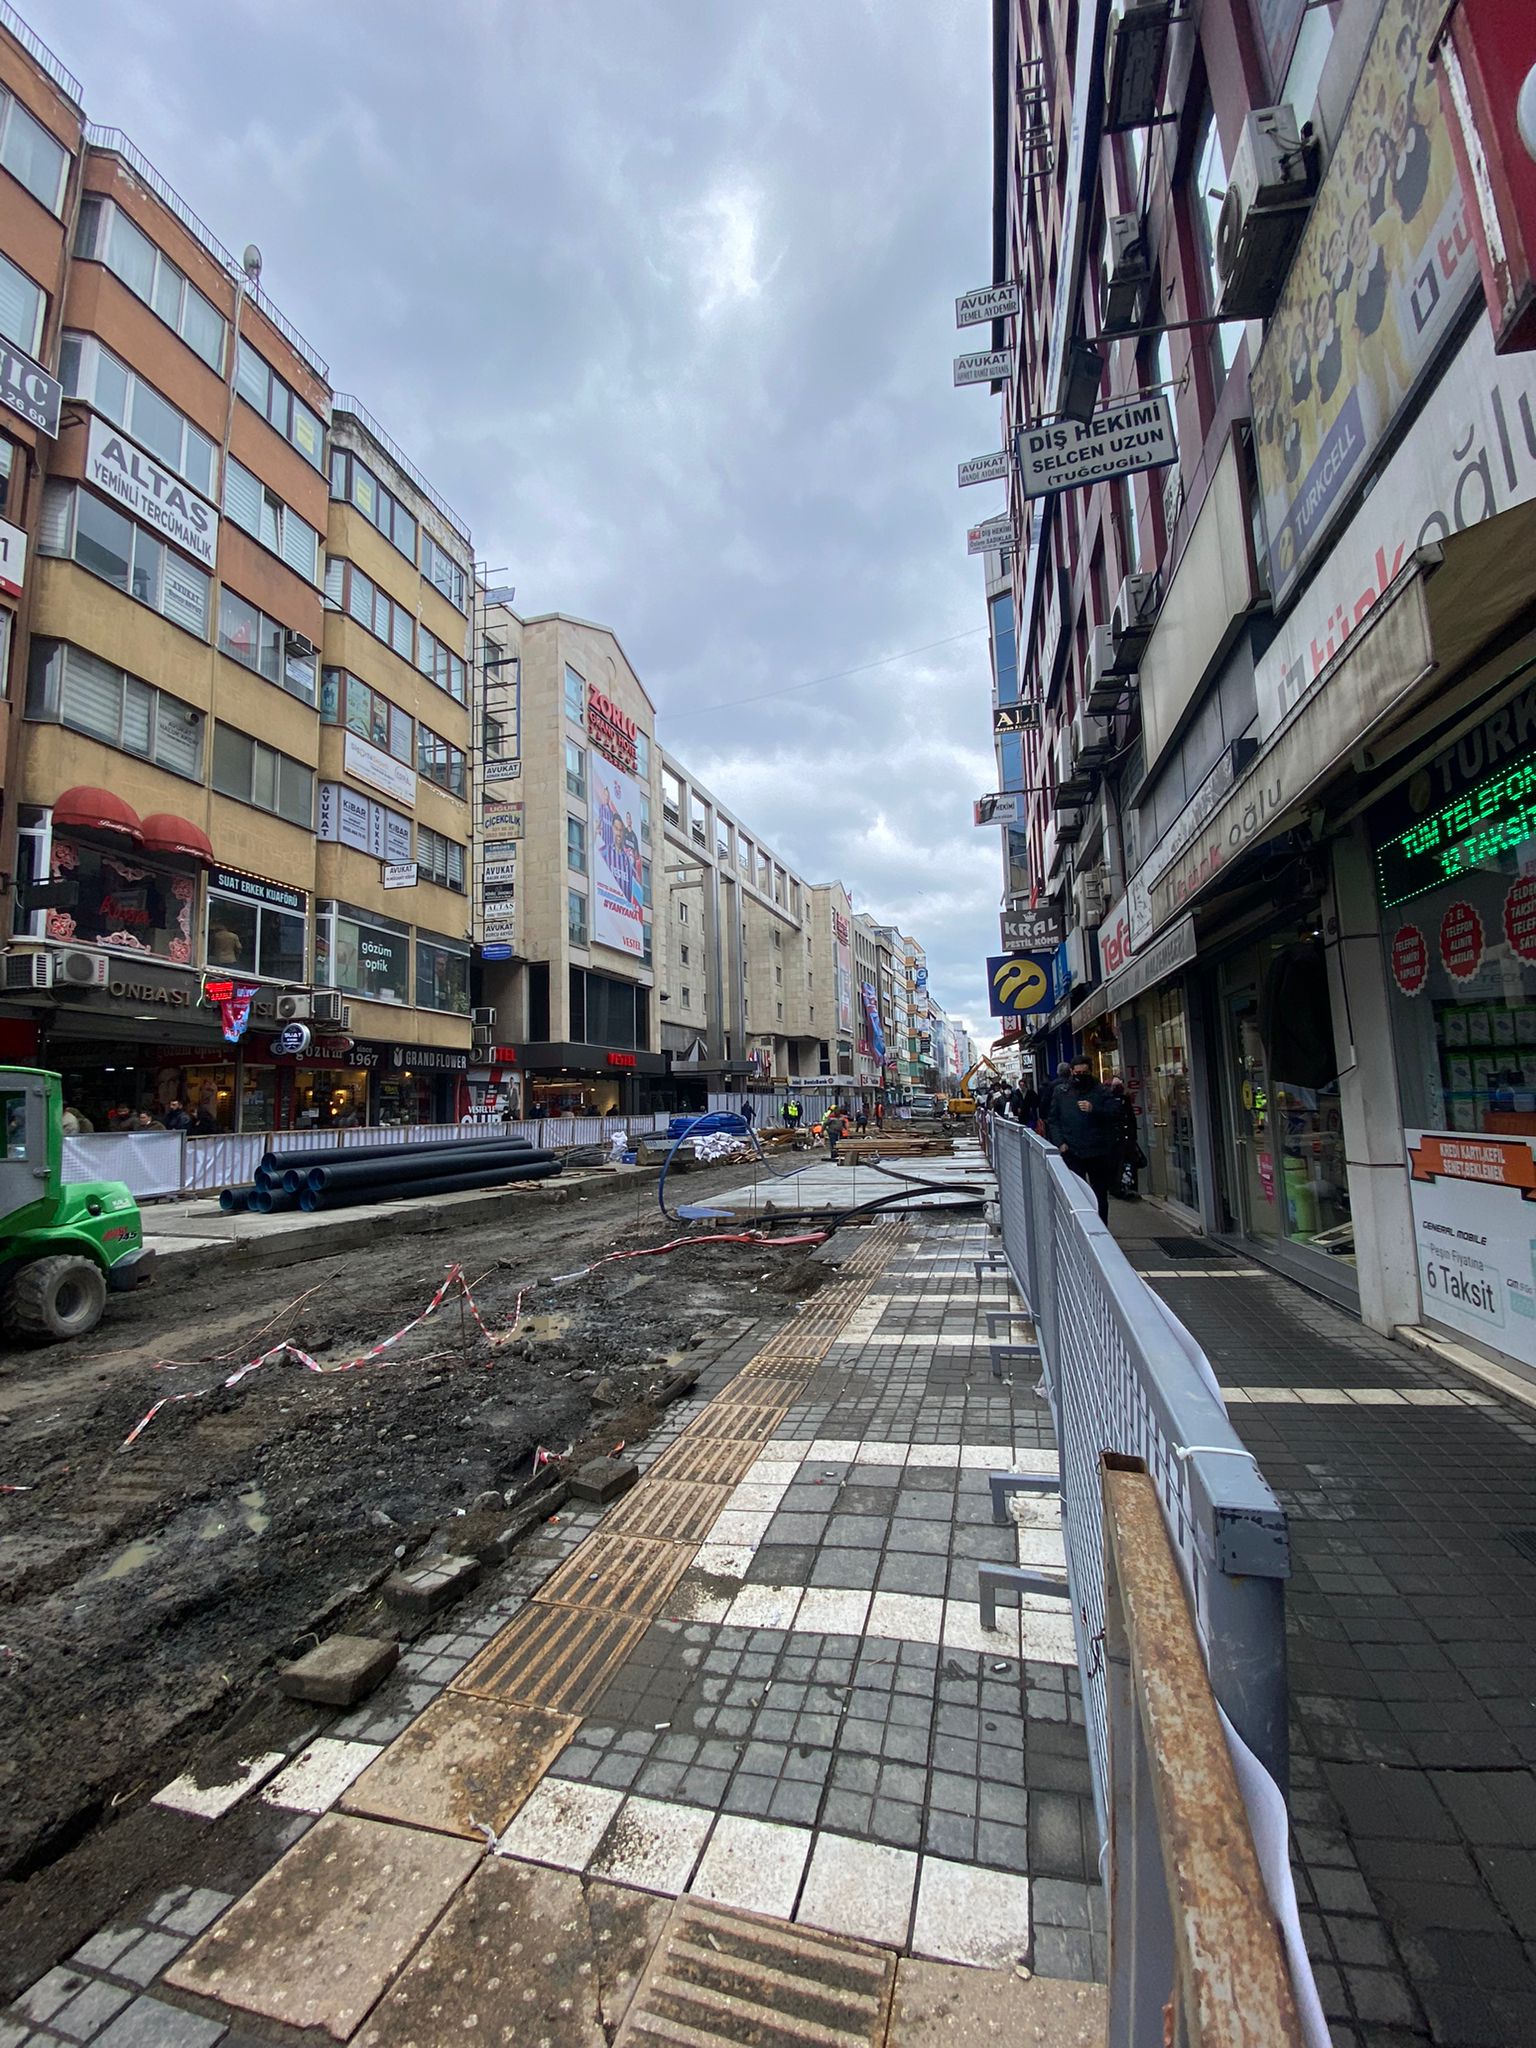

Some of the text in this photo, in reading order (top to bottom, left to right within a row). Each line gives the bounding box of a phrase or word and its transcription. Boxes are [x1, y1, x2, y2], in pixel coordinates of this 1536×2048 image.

[960, 287, 1015, 311] AVUKAT
[960, 300, 1017, 323] TEMEL AYDEMİR
[958, 353, 1008, 371] AVUKAT
[29, 407, 47, 427] 60
[1029, 401, 1162, 454] DİŞ HEKİMİ
[1032, 428, 1164, 473] SELCEN UZUN
[961, 456, 1005, 474] AVUKAT
[1047, 451, 1154, 486] (TUĞCUGİL)
[101, 437, 209, 534] ALTAŞ
[1294, 423, 1357, 537] TURKCELL
[94, 458, 213, 561] YEMİNLİ TERCÜMANLIK
[588, 683, 638, 742] ZORLU
[996, 704, 1036, 727] ALİ
[486, 764, 518, 774] AVUKAT
[321, 786, 330, 837] AVUKAT
[390, 865, 413, 875] AVUKAT
[486, 864, 515, 875] AVUKAT
[218, 874, 298, 907] SUAT ERKEK KUAFÖRÜ
[486, 923, 514, 932] AVUKAT
[1004, 917, 1059, 938] KRAL
[1446, 919, 1474, 939] TELEFON
[361, 941, 392, 958] gözüm
[622, 936, 642, 951] VESTEL
[1005, 938, 1033, 949] PESTİL
[365, 958, 389, 972] optik
[356, 1045, 373, 1053] since
[349, 1053, 379, 1066] 1967
[607, 1052, 638, 1067] VESTEL
[1422, 1220, 1487, 1246] GENERAL MOBILE
[1427, 1261, 1495, 1314] 6 Taksit
